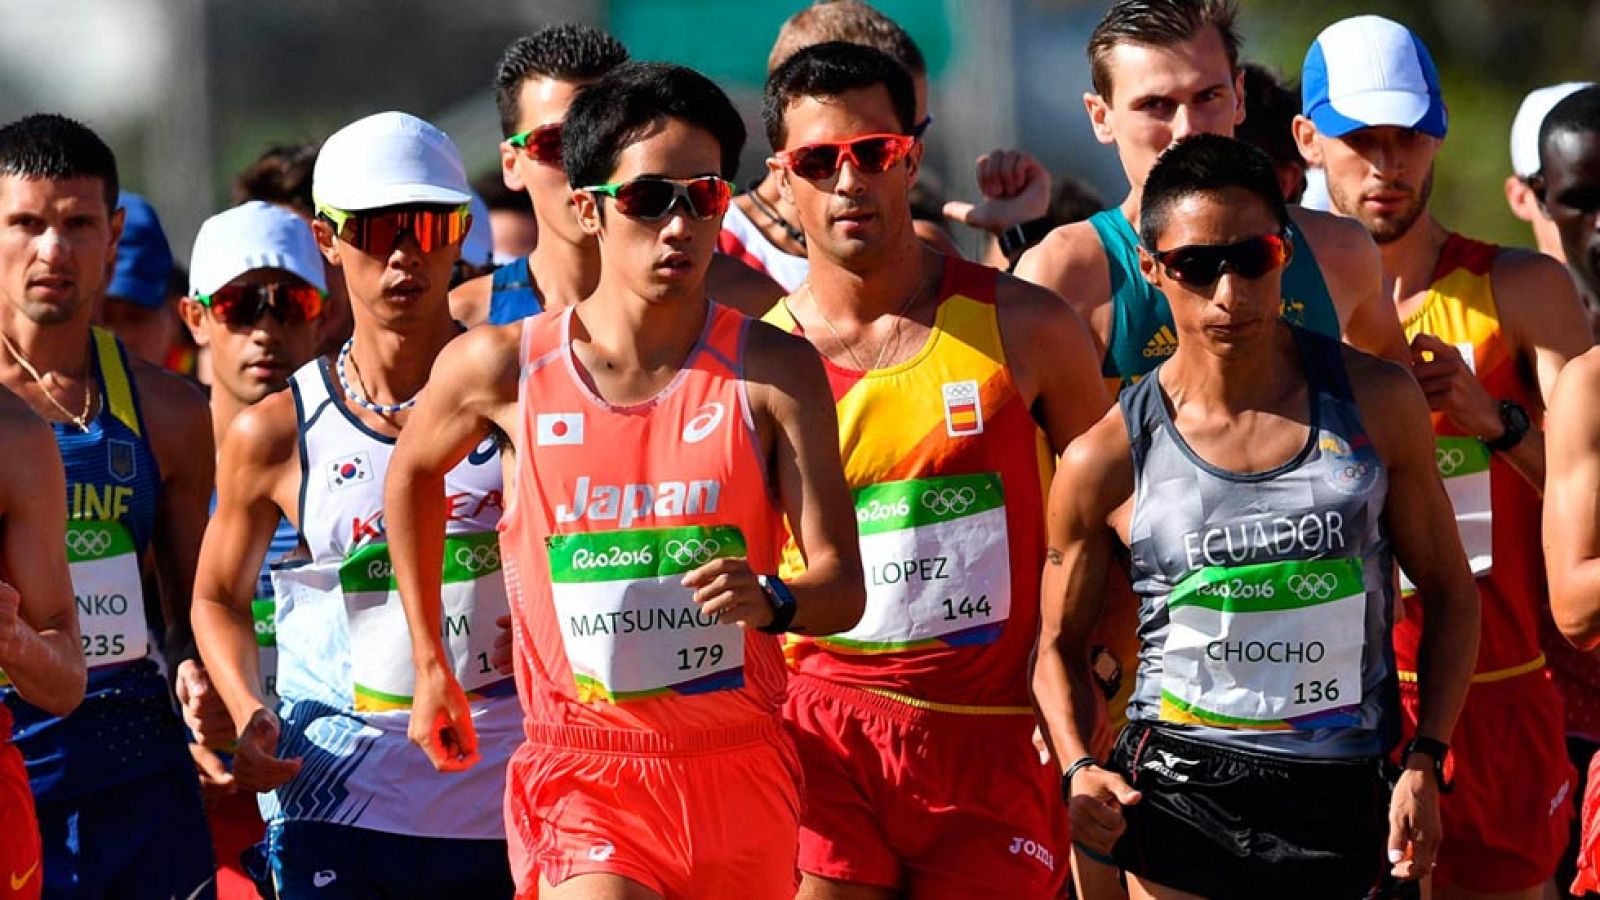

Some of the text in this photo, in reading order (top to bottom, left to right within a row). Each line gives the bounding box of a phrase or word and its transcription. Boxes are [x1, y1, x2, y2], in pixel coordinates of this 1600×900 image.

[555, 476, 721, 528] Japan
[1184, 511, 1344, 570] ECUADOR
[572, 545, 653, 569] Rio2016
[872, 557, 949, 585] LOPEZ
[942, 594, 991, 620] 144
[571, 606, 721, 637] MATSUNAG
[82, 634, 126, 656] 235
[678, 644, 724, 671] 179
[1206, 641, 1325, 663] CHOCHO
[1293, 679, 1339, 704] 136
